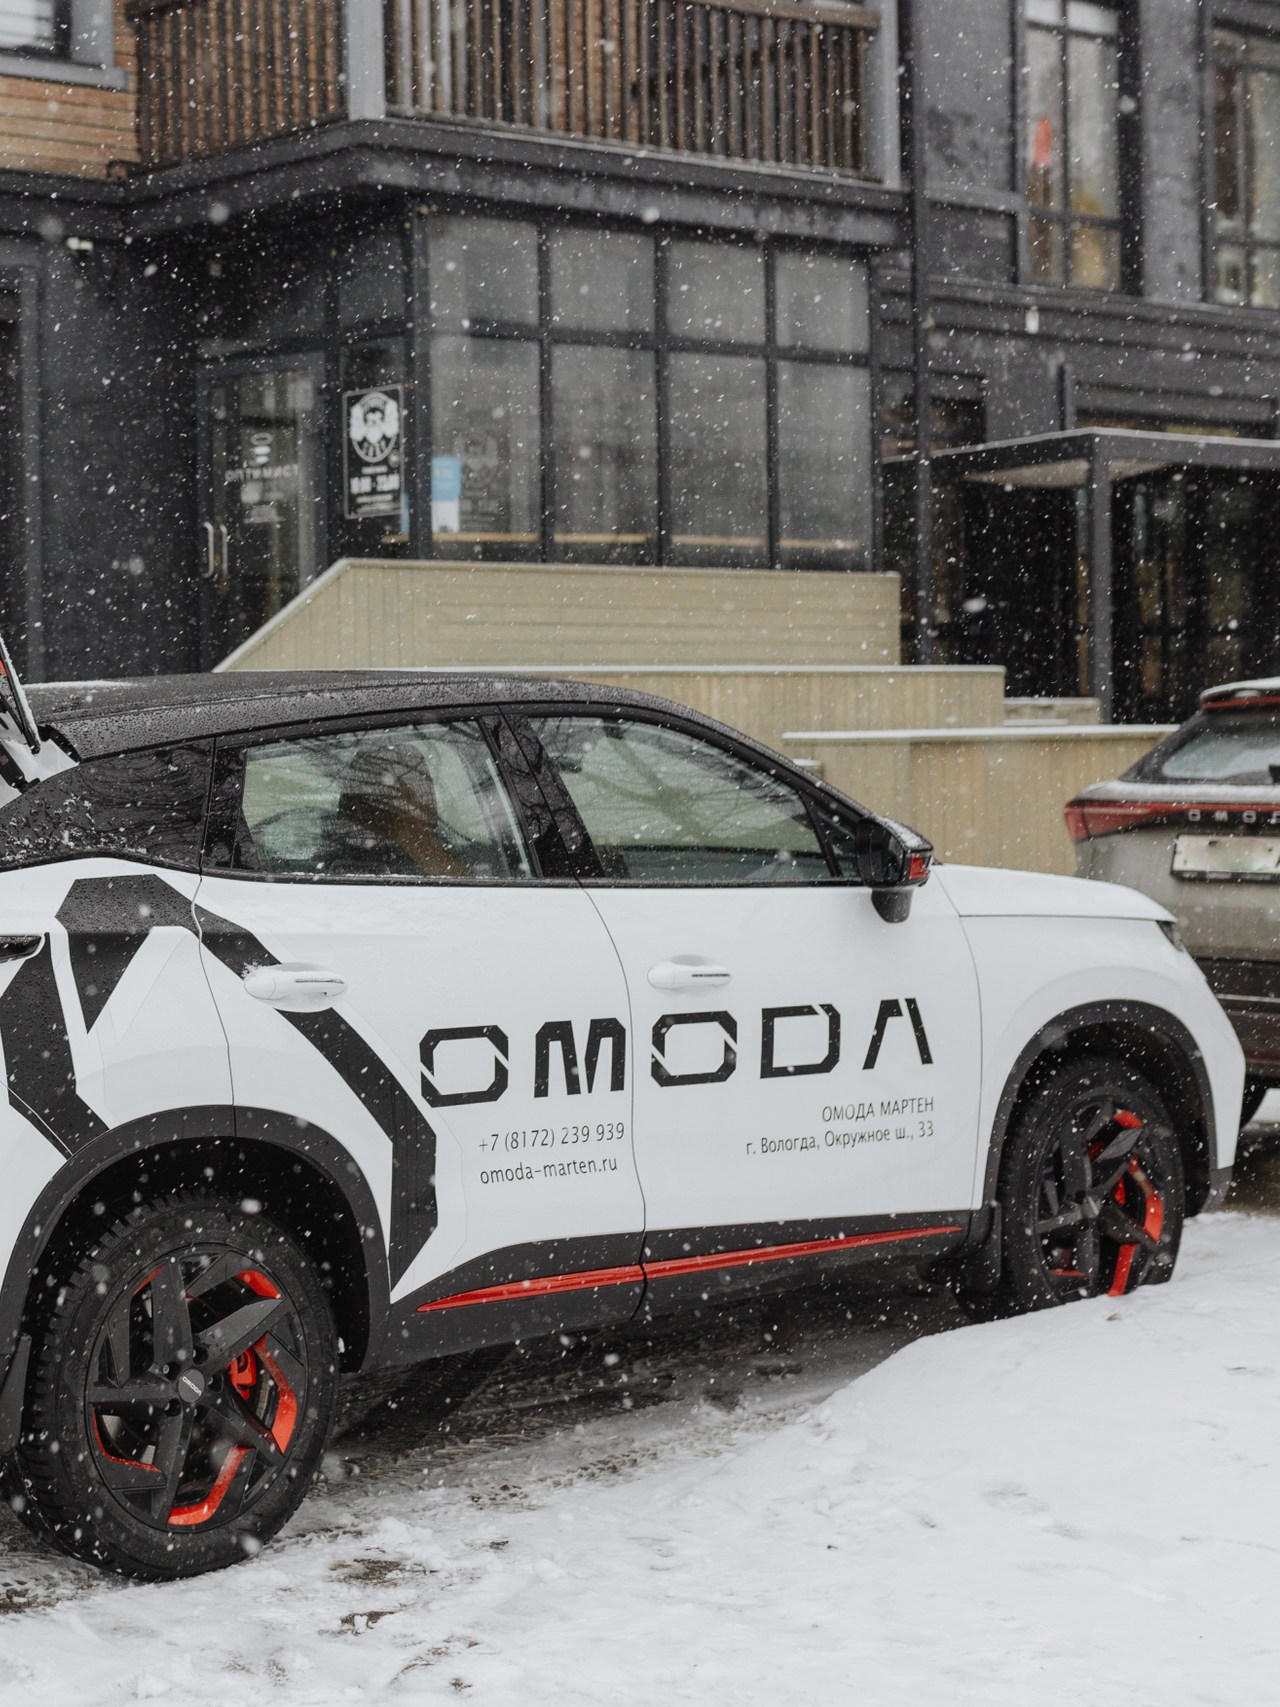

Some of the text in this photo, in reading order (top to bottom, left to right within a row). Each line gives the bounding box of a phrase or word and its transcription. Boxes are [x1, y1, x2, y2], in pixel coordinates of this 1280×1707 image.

[419, 997, 934, 1108] OMODA
[822, 1096, 934, 1122] ОМОДА МАРТЕН
[478, 1122, 625, 1153] +7 (8172) 239 939
[746, 1120, 934, 1155] г. Вологда, Окружное ш., 33
[480, 1158, 618, 1185] omoda-marten.ru
